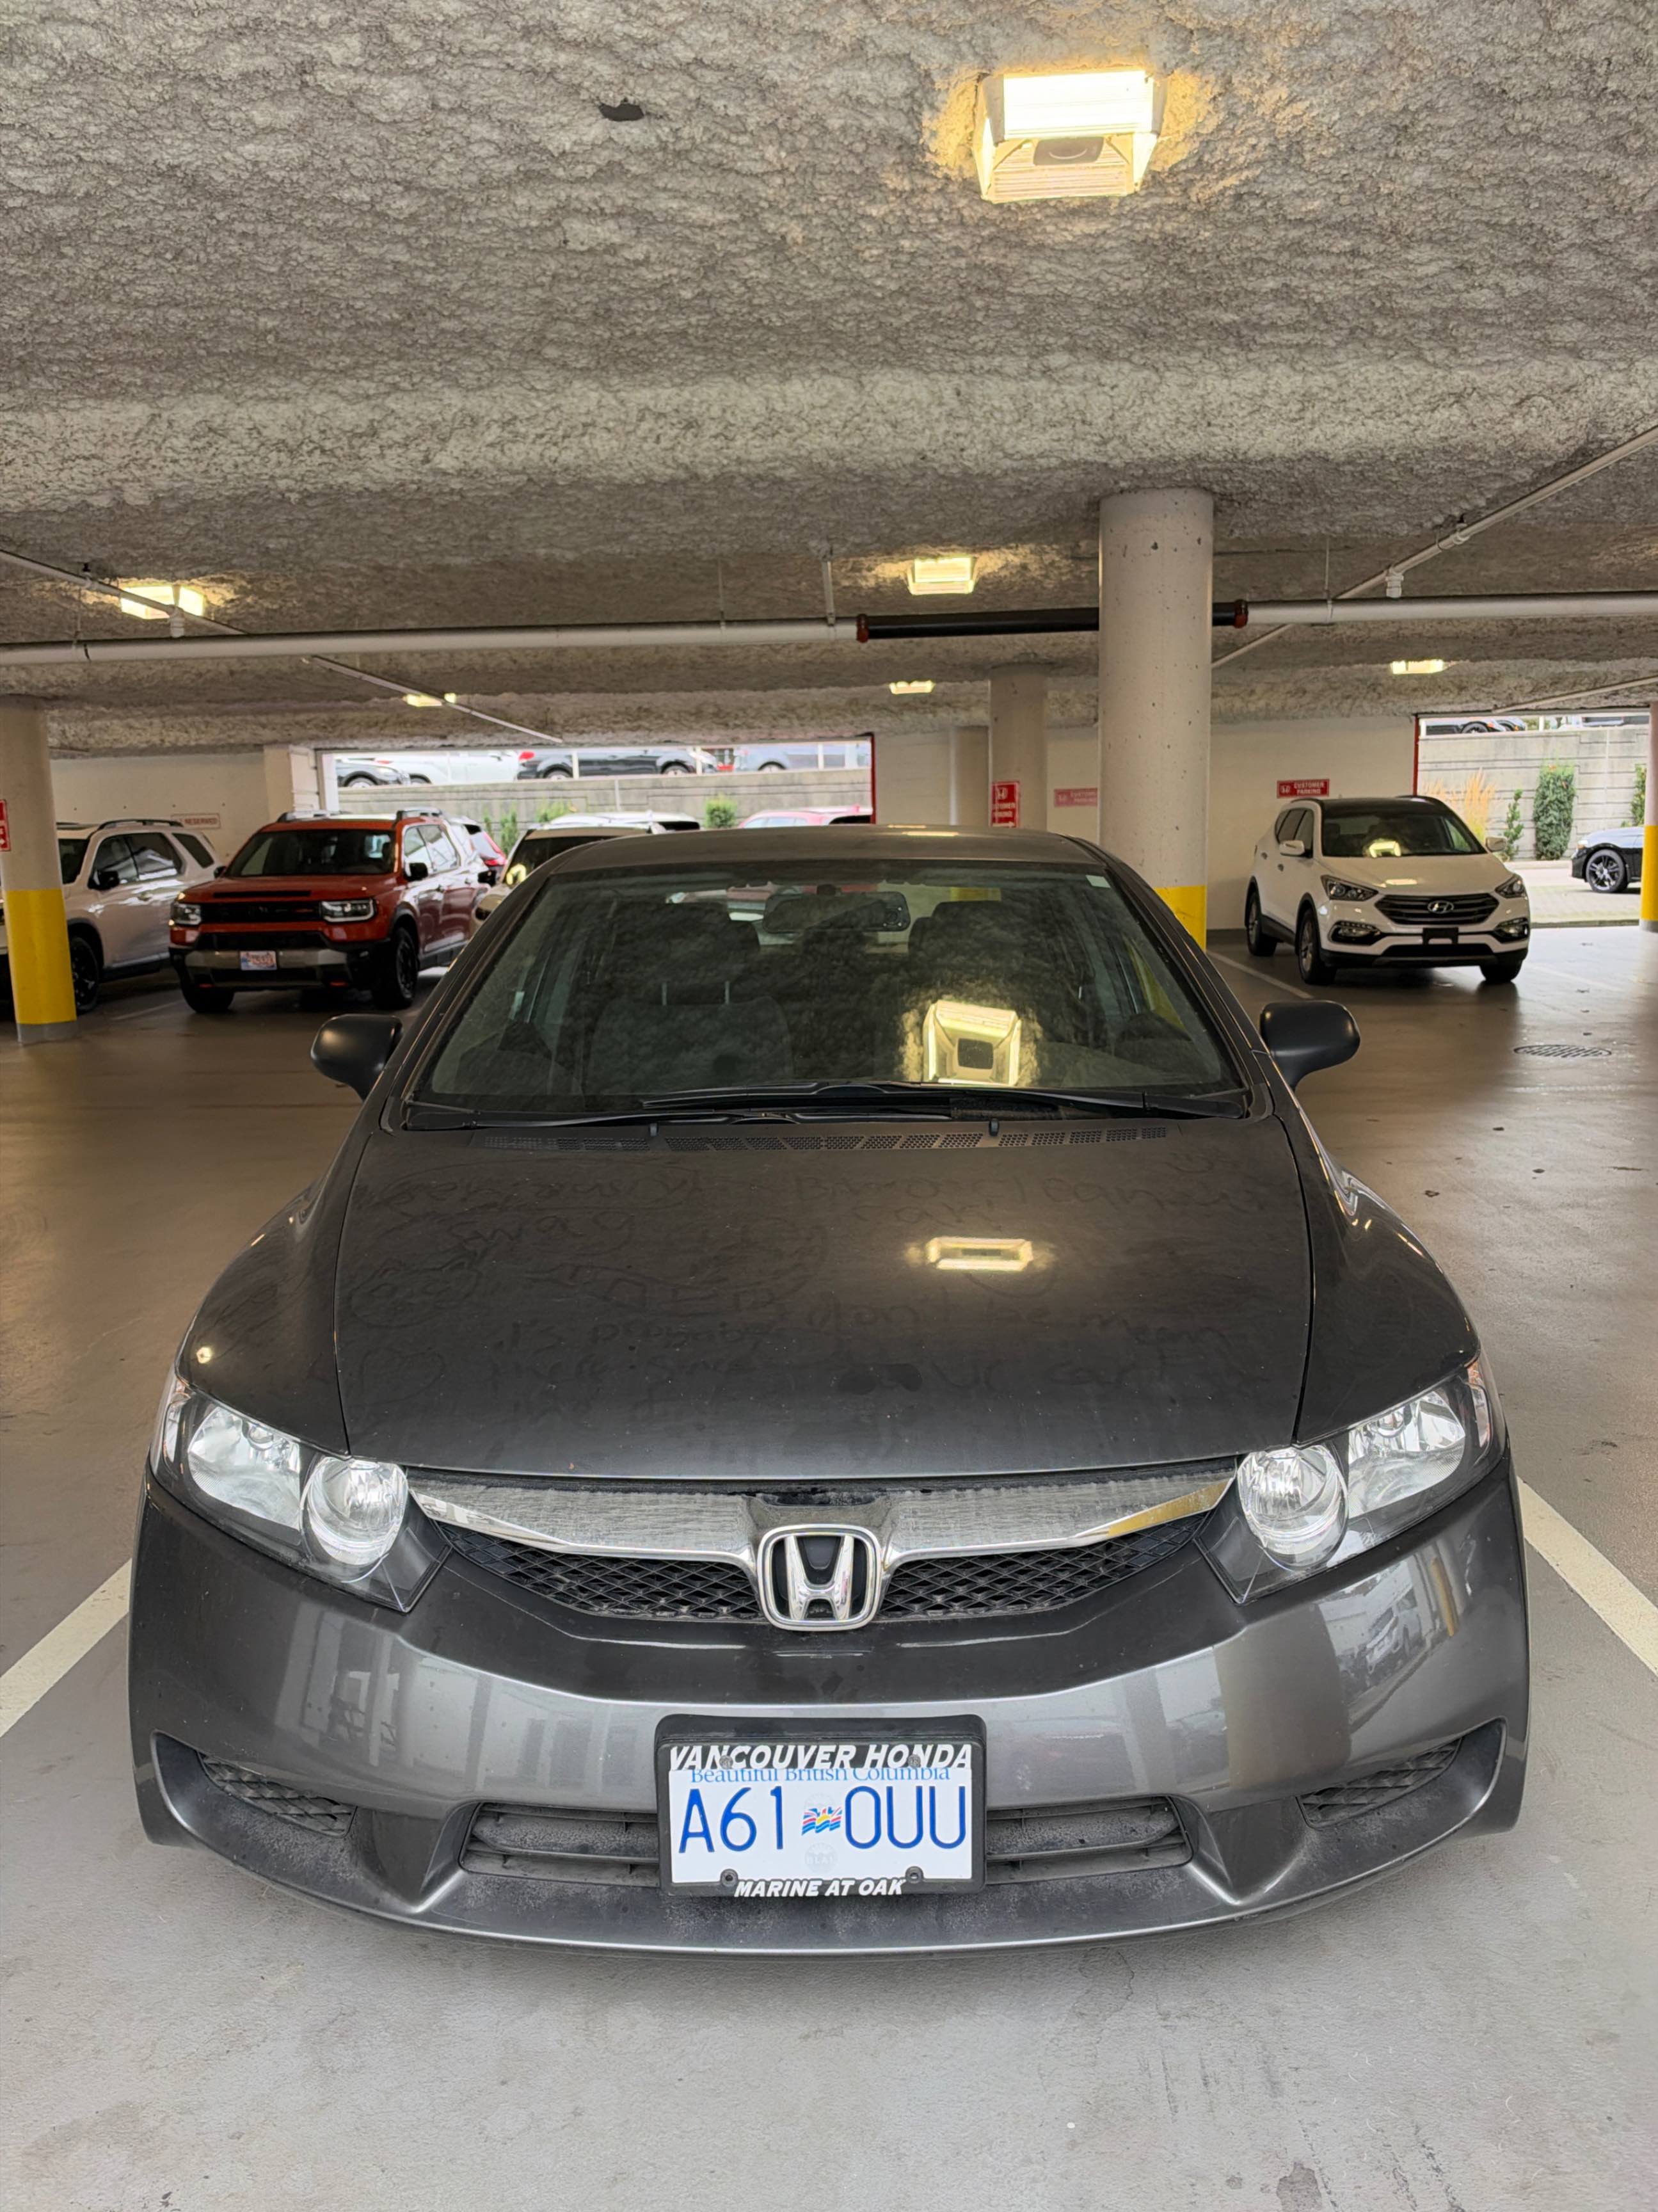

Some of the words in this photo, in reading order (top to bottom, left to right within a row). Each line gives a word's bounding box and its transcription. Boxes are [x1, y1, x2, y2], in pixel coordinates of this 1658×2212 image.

[670, 1745, 857, 1770] VANCOUVER
[863, 1743, 972, 1769] HONDA
[678, 1786, 784, 1854] A61
[733, 1880, 823, 1898] MARINE
[824, 1880, 856, 1896] AT
[858, 1879, 907, 1896] OAK
